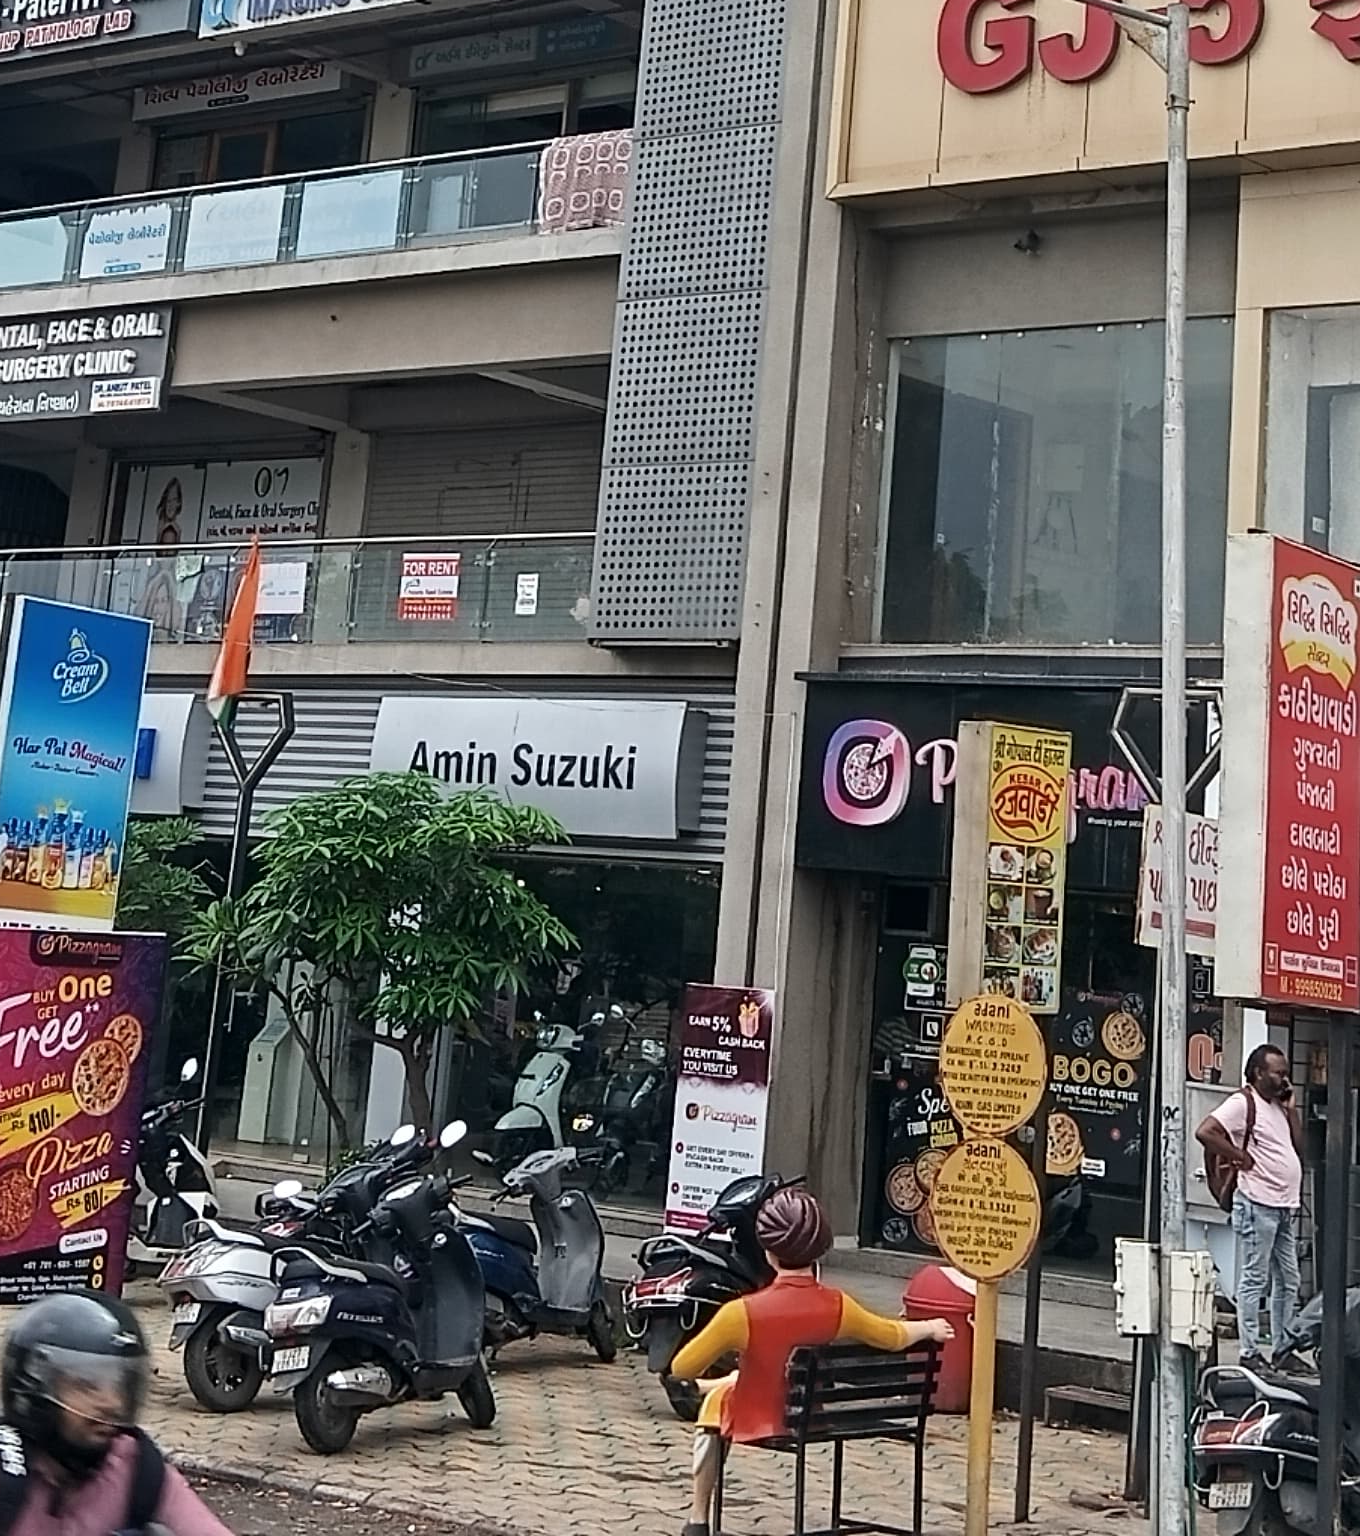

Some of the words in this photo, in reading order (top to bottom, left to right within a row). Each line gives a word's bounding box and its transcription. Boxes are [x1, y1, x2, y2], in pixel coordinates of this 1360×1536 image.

[24, 17, 99, 48] PATHOLOGY
[103, 10, 132, 34] LAB
[72, 349, 136, 378] CLINIC
[403, 560, 426, 575] FOR
[427, 560, 459, 577] RENT
[52, 660, 100, 681] Cream
[61, 678, 91, 696] Bell
[1276, 676, 1358, 738] કાઠીયાવાડી
[13, 737, 42, 755] Har
[44, 738, 68, 758] Pal
[69, 741, 125, 774] Magical!
[409, 740, 497, 784] Amin
[510, 743, 638, 791] Suzuki
[1292, 735, 1341, 773] ગુજરાતી
[1295, 773, 1336, 813] પંજાબી
[1289, 821, 1341, 856] દાલબાટી
[33, 988, 56, 1004] BUY
[58, 974, 112, 1002] One
[37, 1005, 59, 1020] GET
[689, 1015, 711, 1026] EARN
[711, 1016, 732, 1033] 5%
[974, 1002, 1010, 1018] adani
[683, 1048, 732, 1062] EVERYTIME
[718, 1035, 741, 1047] CASH
[741, 1038, 765, 1050] BACK
[41, 1071, 67, 1092] day
[682, 1061, 701, 1072] YOU
[702, 1063, 724, 1075] VISIT
[726, 1064, 738, 1076] US
[1052, 1055, 1136, 1088] BOGO
[26, 1132, 114, 1190] Pizza
[966, 1142, 1001, 1158] adani
[48, 1165, 111, 1201] STARTING
